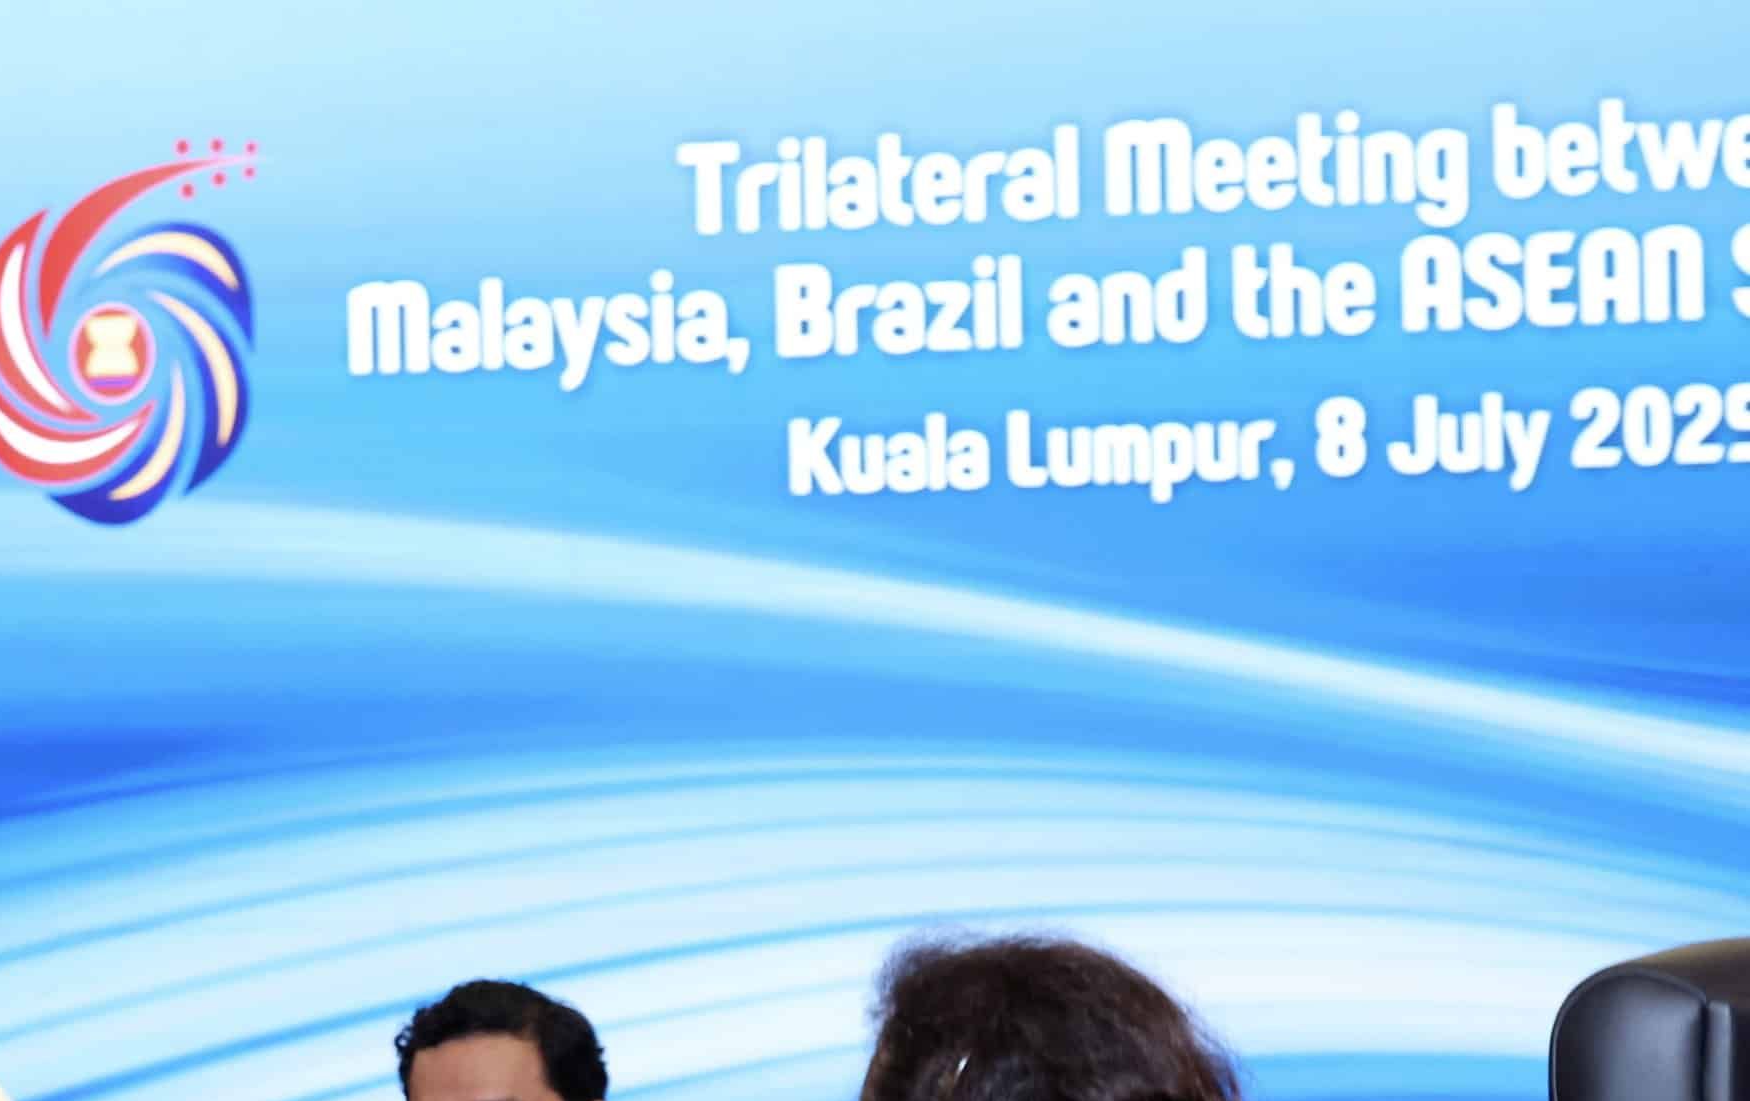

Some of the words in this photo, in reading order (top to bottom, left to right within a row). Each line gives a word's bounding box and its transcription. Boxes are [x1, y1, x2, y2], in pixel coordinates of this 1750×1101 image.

[676, 122, 1080, 236] Trilateral
[1104, 110, 1470, 228] Meeting
[347, 270, 751, 391] Malaysia,
[774, 254, 1025, 358] Brazil
[1048, 245, 1207, 349] and
[1233, 243, 1376, 338] the
[1402, 225, 1704, 334] ASEAN
[789, 412, 989, 496] Kuala
[1007, 409, 1296, 503] Lumpur,
[1317, 396, 1367, 478] 8
[1387, 391, 1551, 490] July
